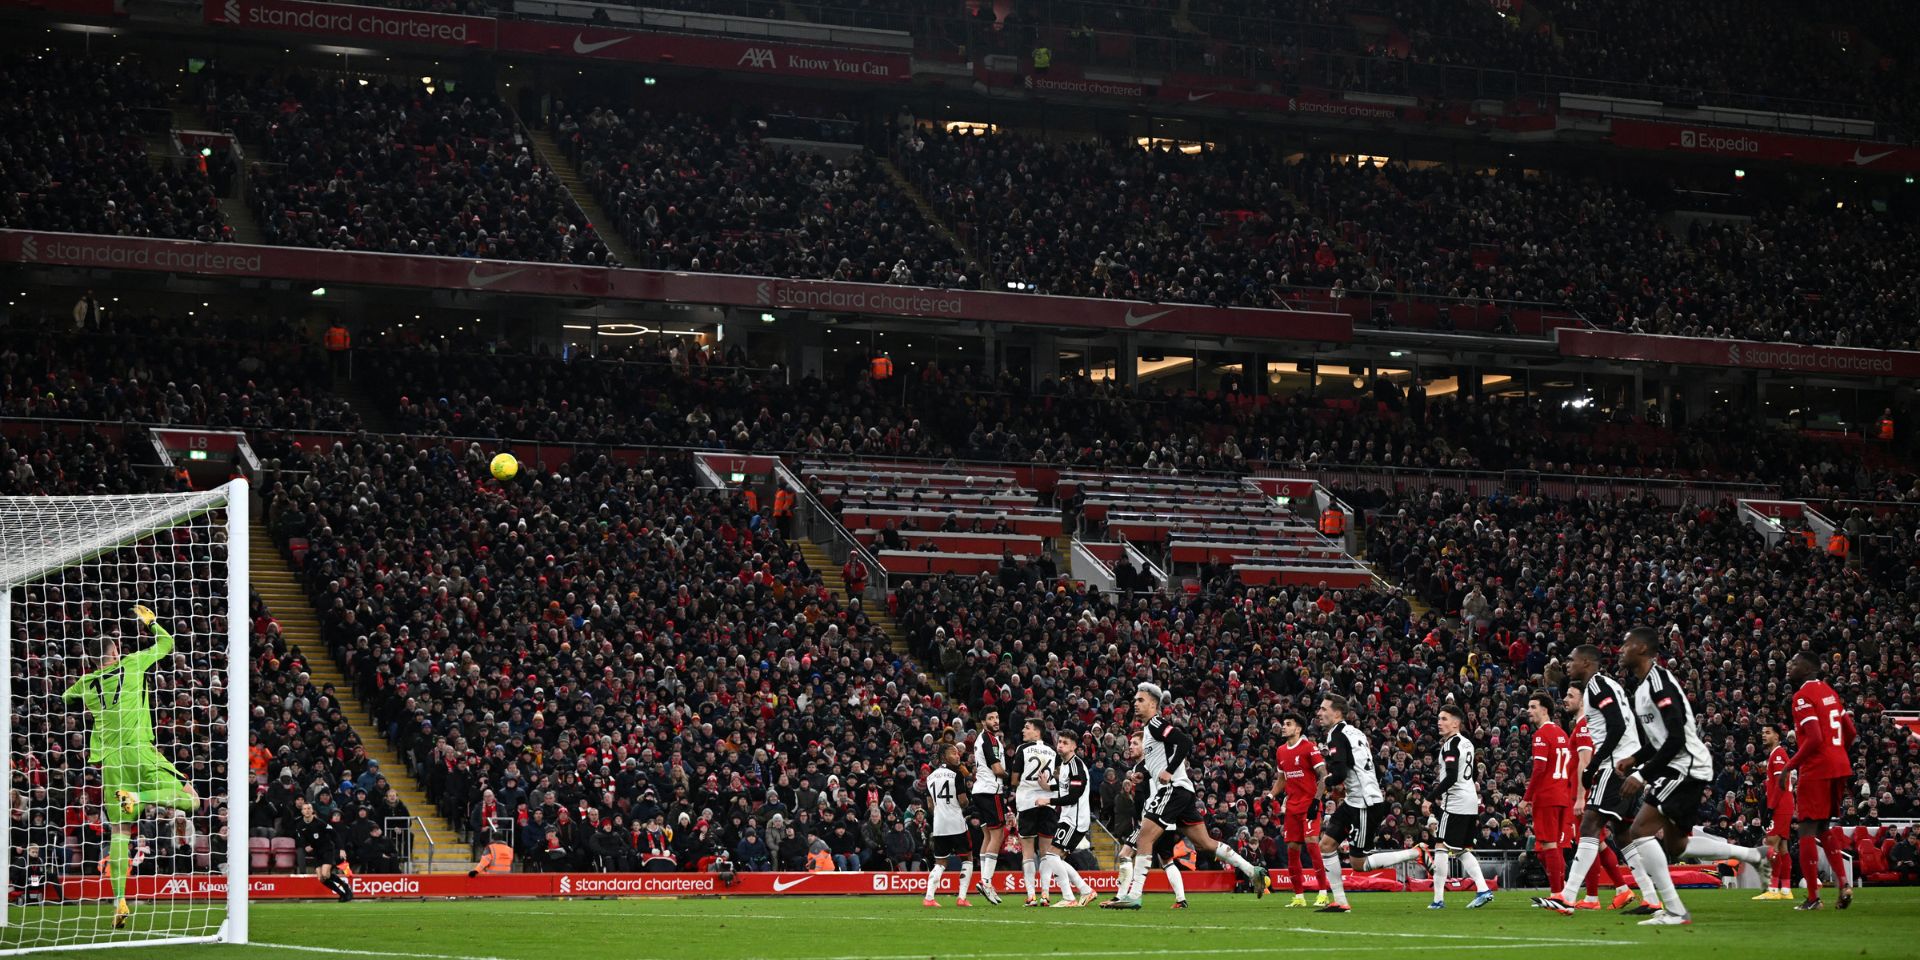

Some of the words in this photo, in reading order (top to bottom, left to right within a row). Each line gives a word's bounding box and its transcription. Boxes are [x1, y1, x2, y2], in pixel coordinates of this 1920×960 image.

[249, 4, 352, 31] standard
[358, 15, 467, 41] chartered
[737, 47, 777, 69] AXA
[788, 55, 830, 70] Know
[833, 59, 859, 74] You
[862, 61, 889, 76] Can
[1036, 78, 1087, 91] standard
[1088, 83, 1142, 96] chartered
[1299, 102, 1347, 115] standard
[1699, 133, 1759, 153] Expedia
[46, 240, 149, 264] standard
[154, 248, 261, 272] chartered
[777, 286, 865, 308] standard
[870, 291, 962, 314] chartered
[1745, 349, 1816, 367] standard
[1818, 351, 1893, 372] chartered
[189, 437, 208, 449] L8
[730, 460, 747, 472] L7
[1275, 483, 1290, 496] L6
[1768, 505, 1781, 517] L5
[90, 666, 125, 710] 17
[1829, 709, 1842, 746] 5
[1025, 756, 1054, 783] 26
[1463, 752, 1473, 781] 8
[1552, 747, 1571, 779] 17
[930, 780, 954, 805] 14
[160, 879, 190, 894] AXA
[254, 881, 275, 892] Can
[352, 877, 419, 896] Expedia
[575, 877, 641, 891] standard
[644, 877, 714, 891] chartered
[891, 875, 951, 892] Expea
